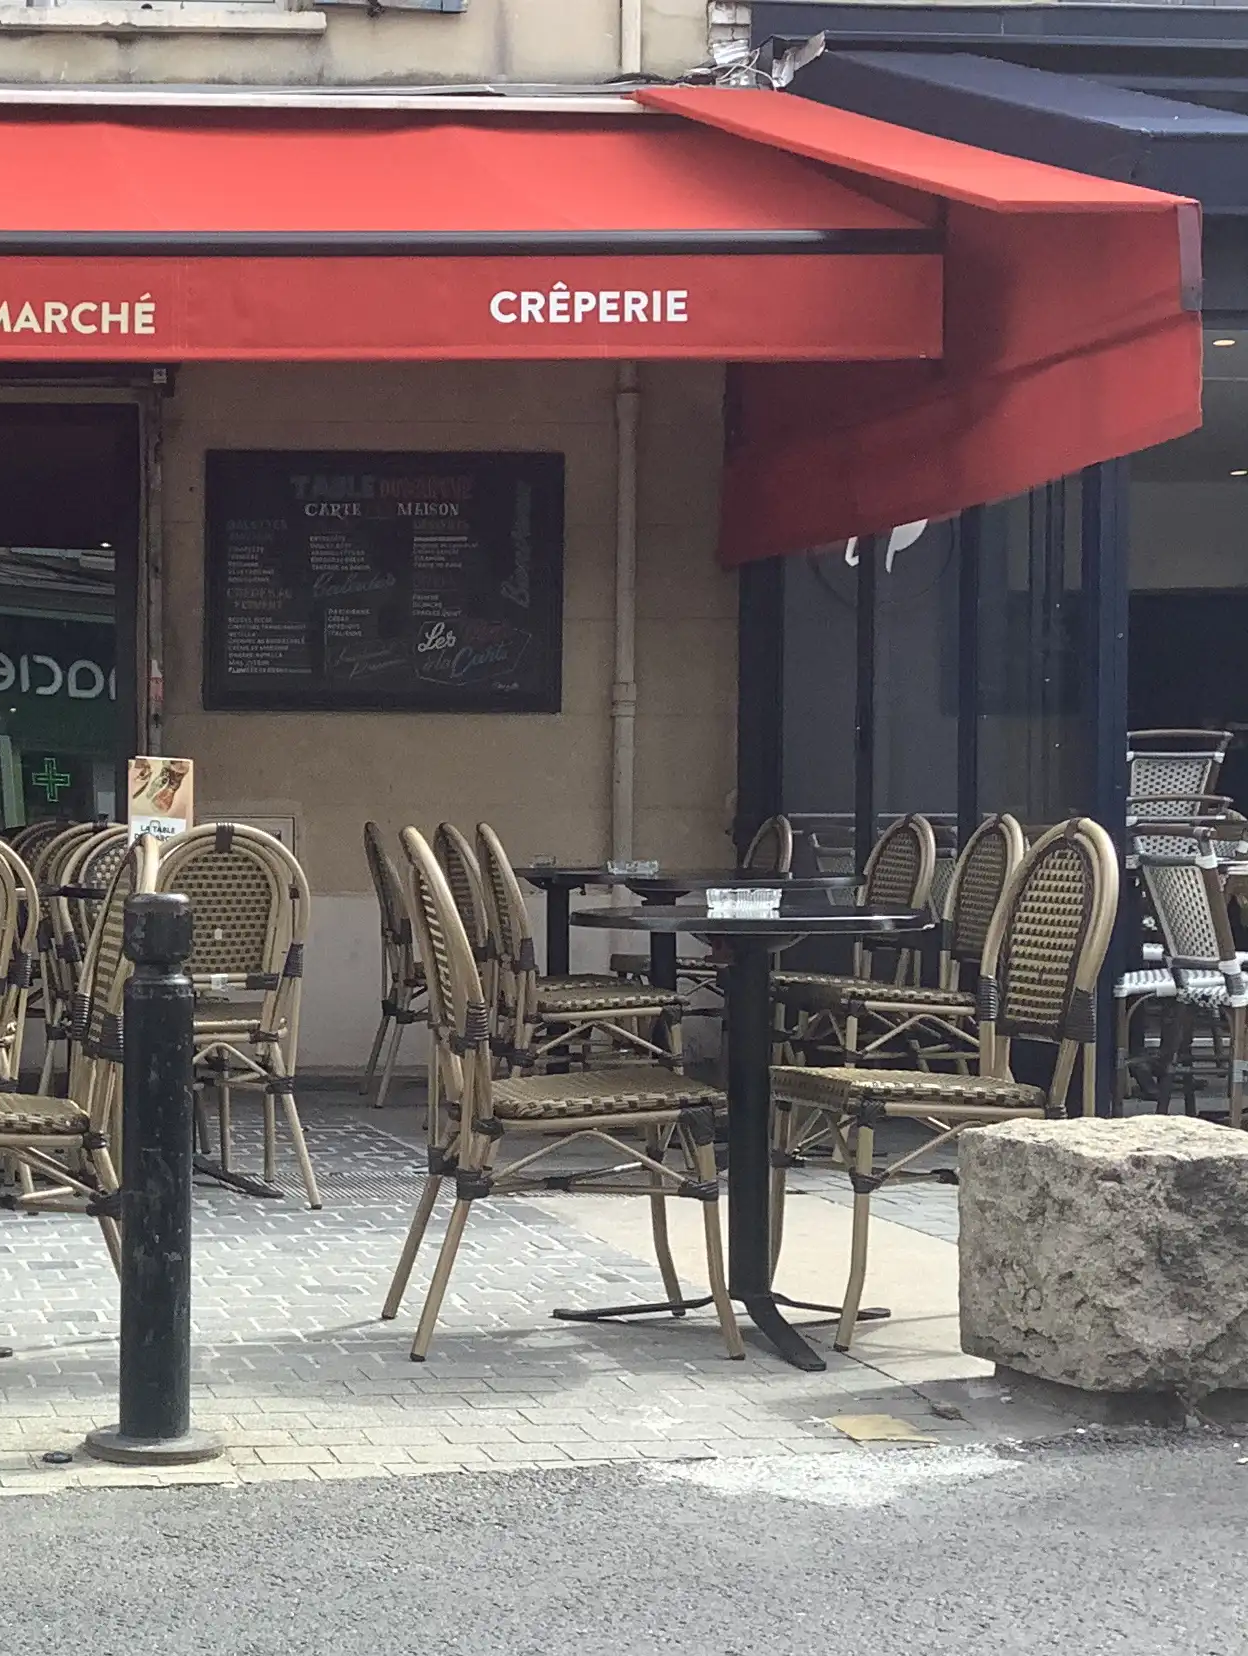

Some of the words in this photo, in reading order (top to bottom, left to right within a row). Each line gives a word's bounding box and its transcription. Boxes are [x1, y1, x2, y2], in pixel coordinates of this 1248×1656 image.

[489, 280, 689, 324] CRÊPERIE
[303, 501, 362, 520] CARTE
[396, 501, 460, 517] MAISON
[417, 621, 457, 653] Les
[140, 824, 151, 832] LA
[152, 825, 176, 834] TABLE
